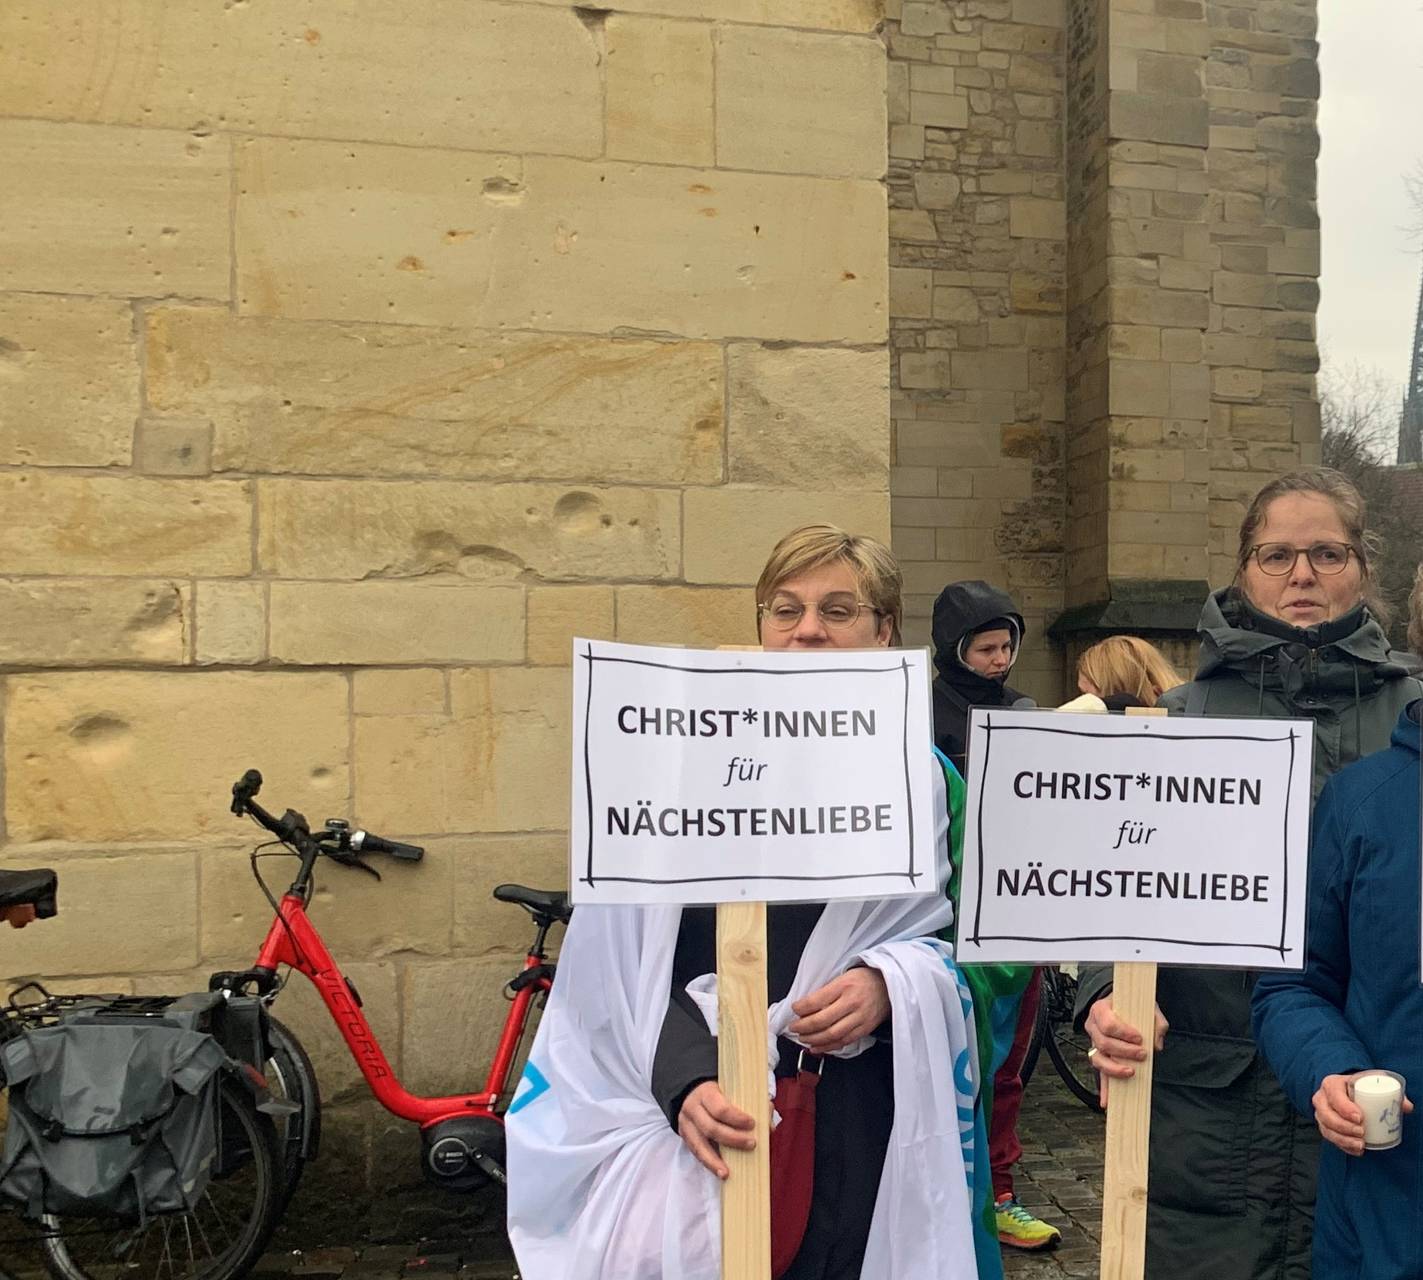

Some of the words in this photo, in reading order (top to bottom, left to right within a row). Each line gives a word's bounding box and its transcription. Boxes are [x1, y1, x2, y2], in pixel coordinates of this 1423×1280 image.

[723, 757, 768, 787] für
[607, 800, 892, 837] NÄCHSTENLIEBE
[1112, 820, 1157, 850] für
[996, 861, 1269, 903] NÄCHSTENLIEBE
[320, 968, 388, 1078] VICTORIA
